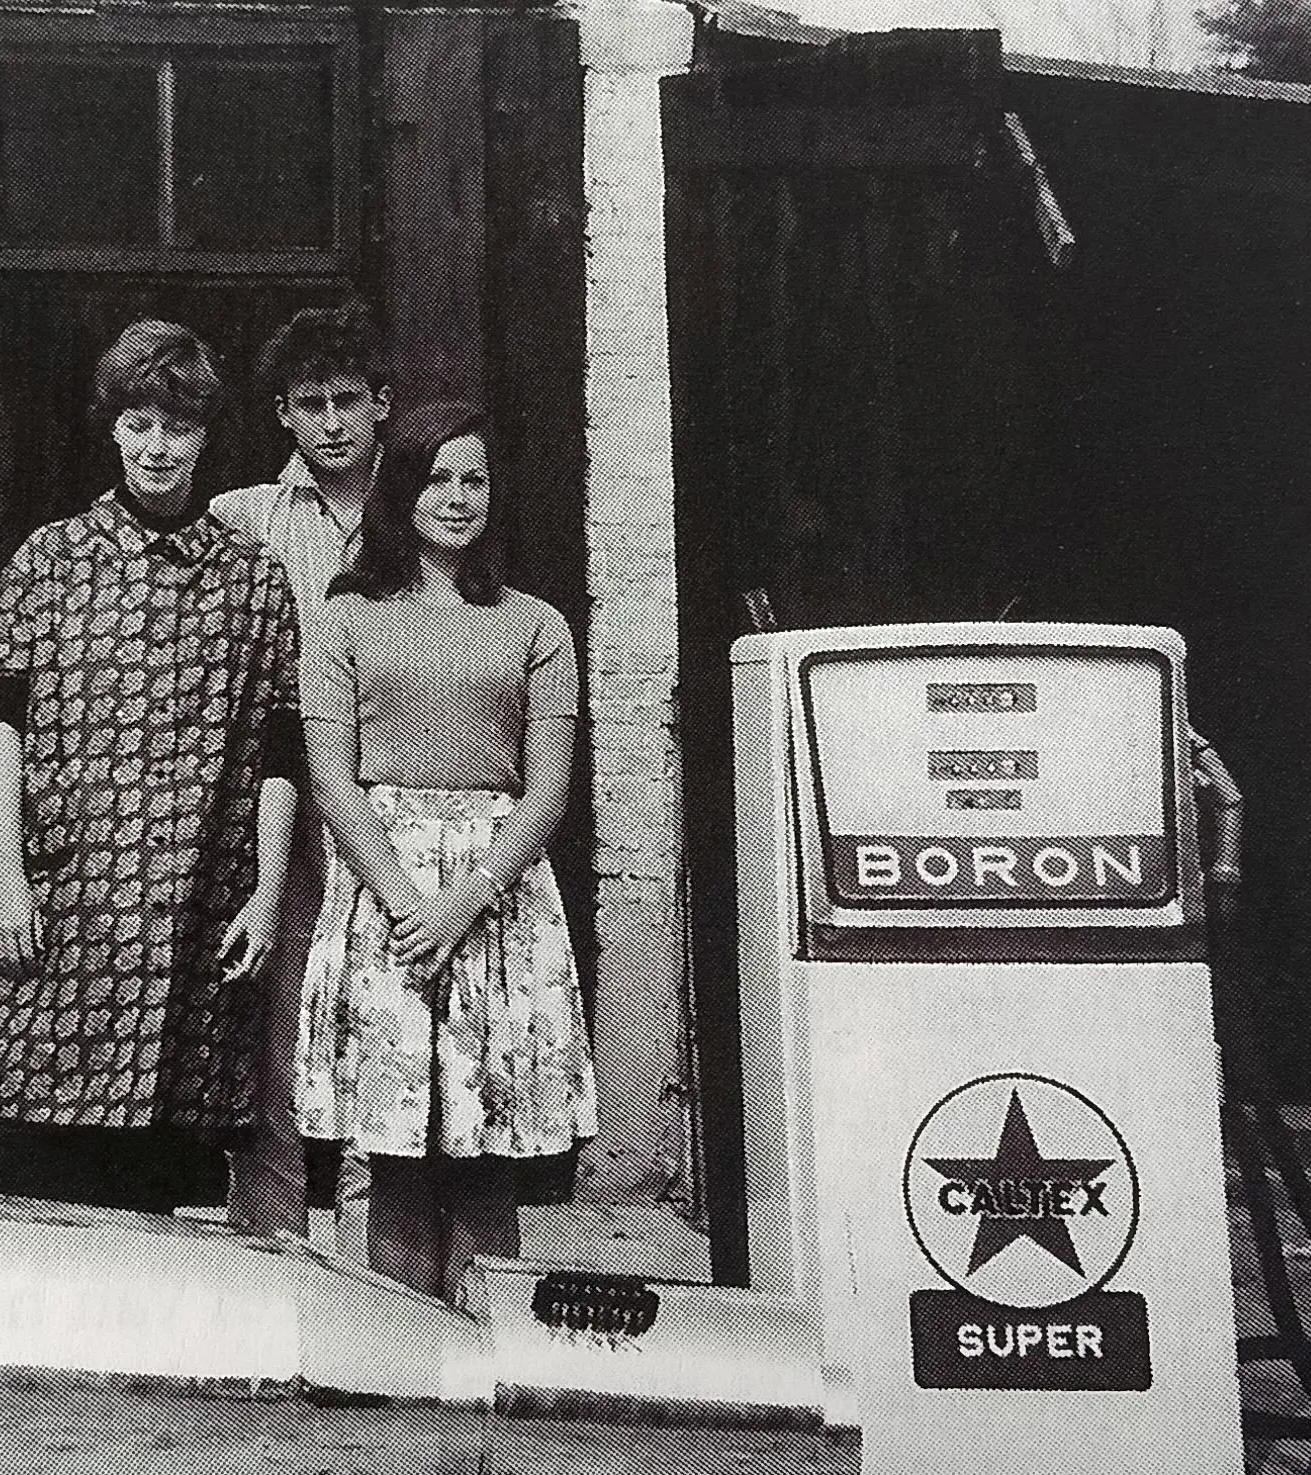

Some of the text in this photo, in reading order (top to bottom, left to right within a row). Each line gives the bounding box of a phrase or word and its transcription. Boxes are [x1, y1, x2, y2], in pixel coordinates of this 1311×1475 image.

[856, 844, 1143, 888] BORON
[937, 1178, 1110, 1218] CALTEX
[957, 1323, 1104, 1358] SUPER
